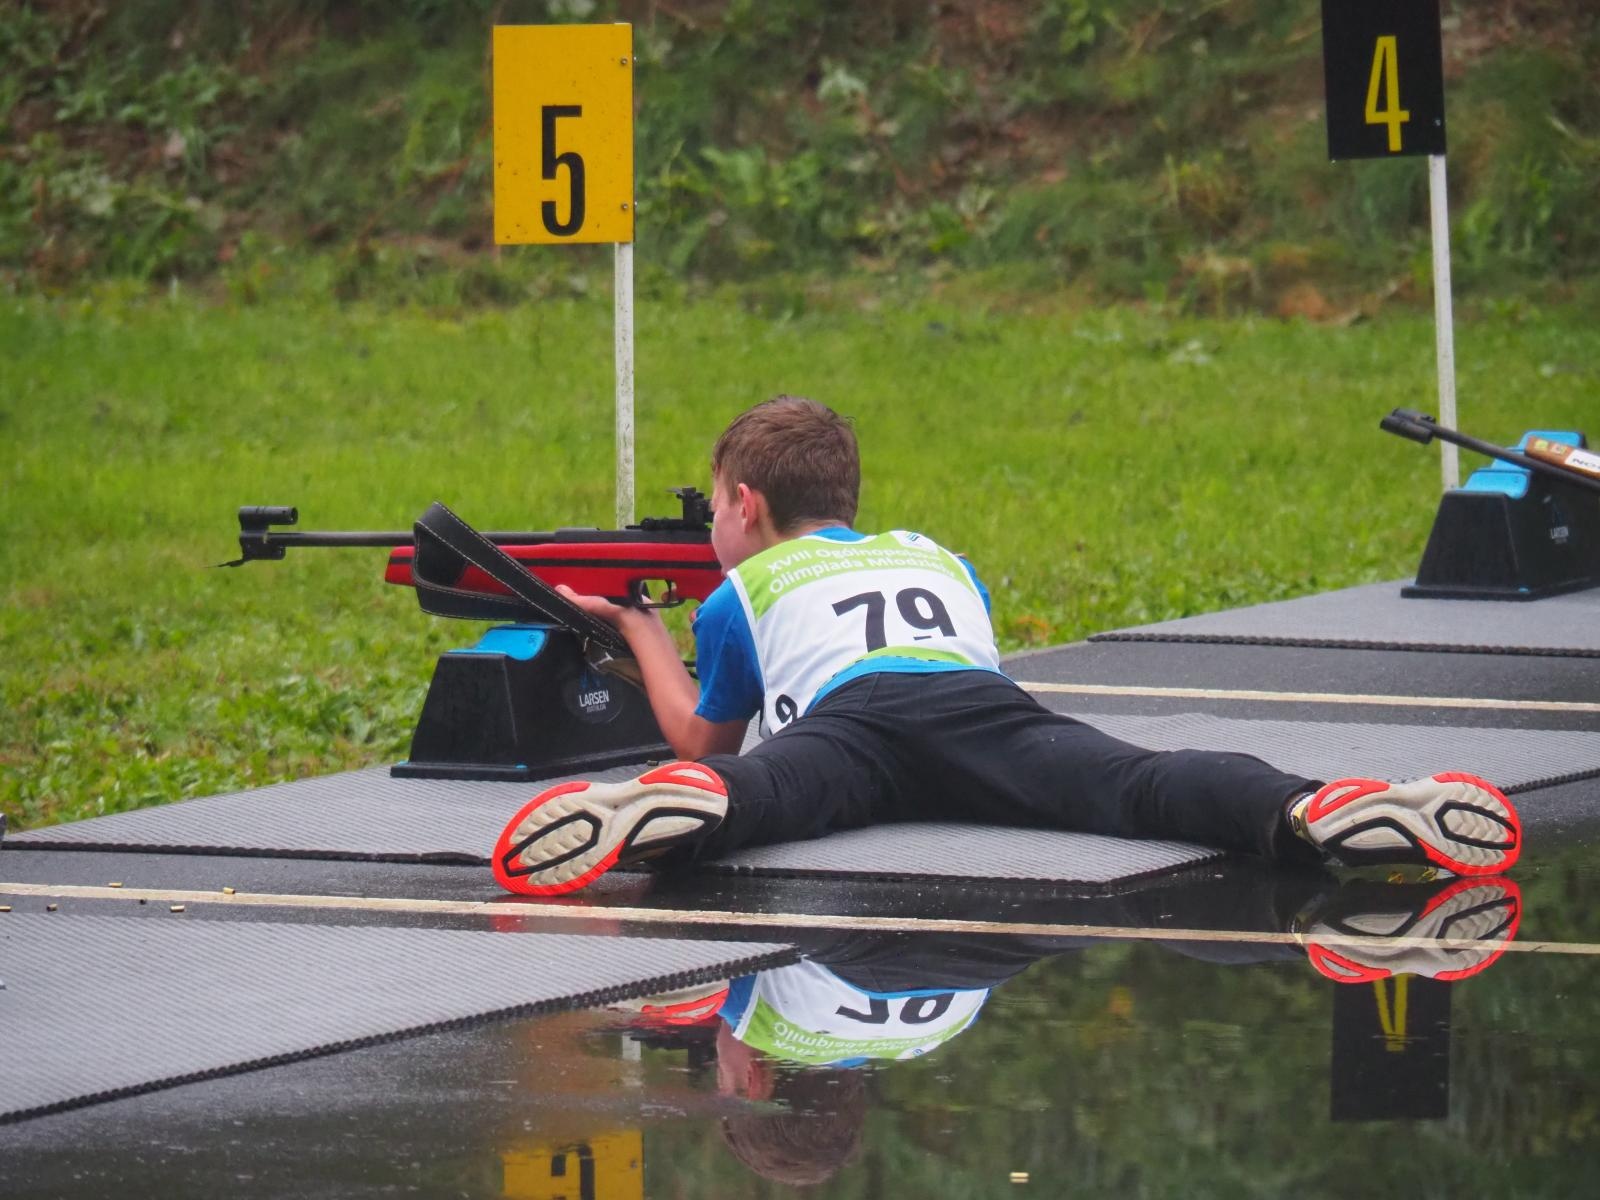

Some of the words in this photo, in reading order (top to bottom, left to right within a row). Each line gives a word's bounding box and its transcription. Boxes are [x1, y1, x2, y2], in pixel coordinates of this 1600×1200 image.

[1365, 35, 1410, 152] 4
[541, 105, 585, 237] 5
[767, 550, 812, 575] XVIII
[815, 547, 942, 562] Ogólnopol
[769, 559, 864, 594] Olimpiada
[831, 587, 957, 653] 79
[578, 688, 609, 708] LARSEN
